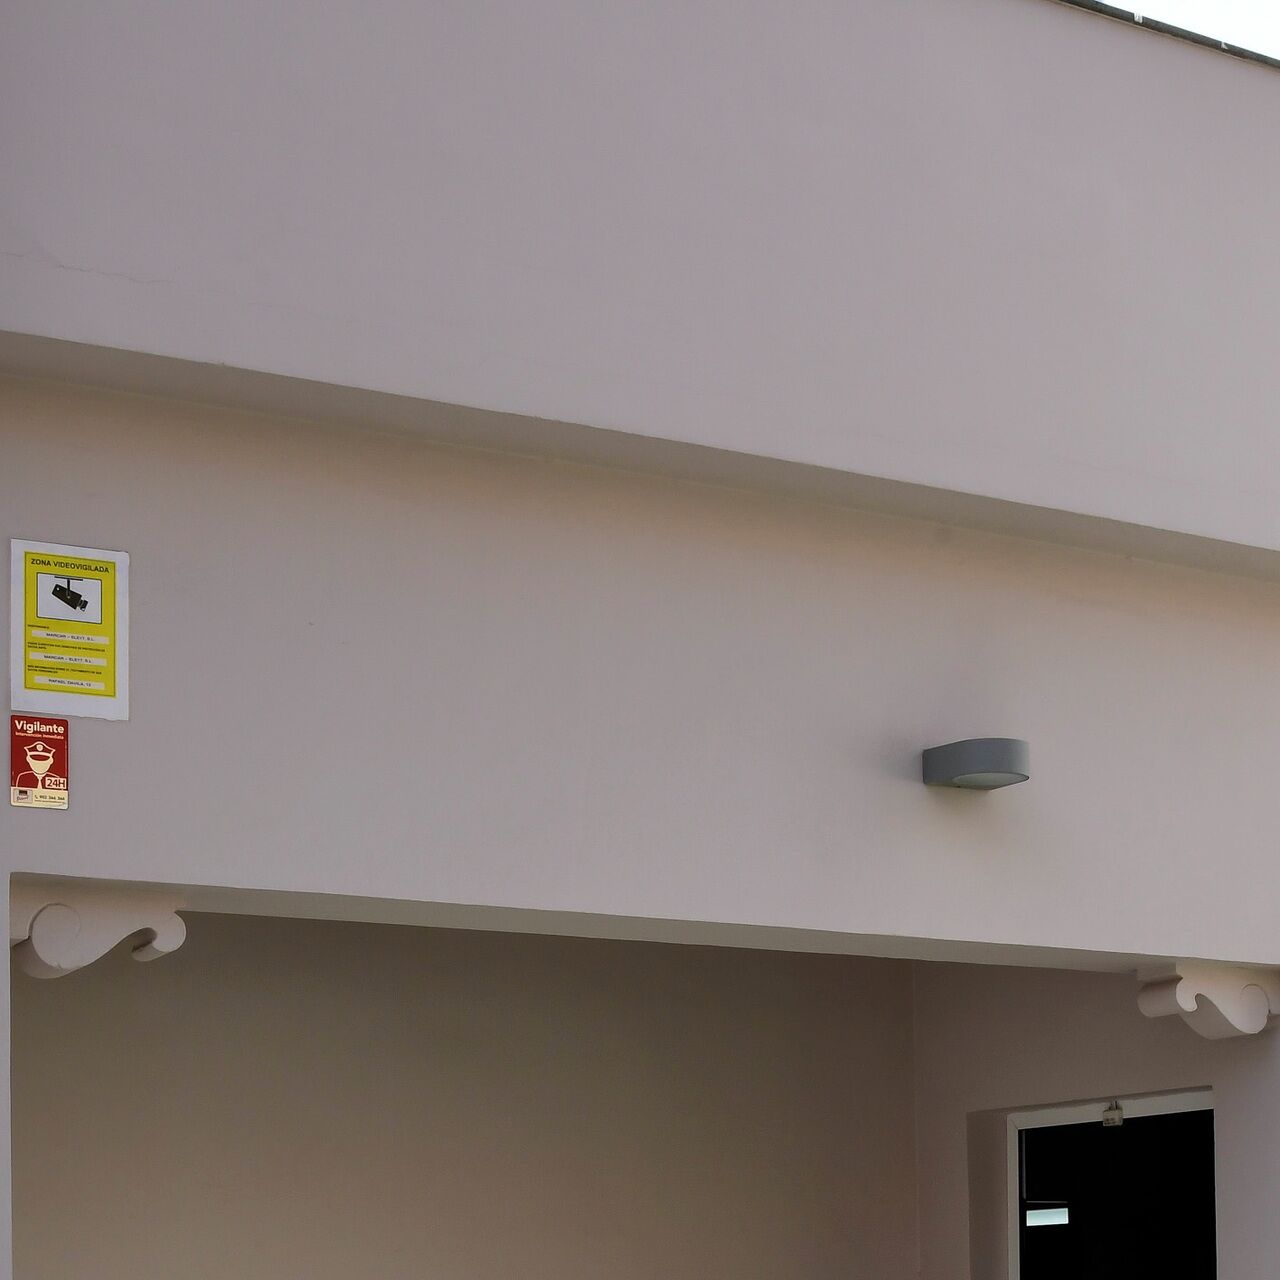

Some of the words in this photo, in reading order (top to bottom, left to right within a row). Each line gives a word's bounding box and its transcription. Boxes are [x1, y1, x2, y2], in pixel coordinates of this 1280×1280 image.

[53, 561, 109, 573] VIDEOVIGILADA
[15, 720, 64, 734] Vigilante
[47, 779, 66, 788] 24H
